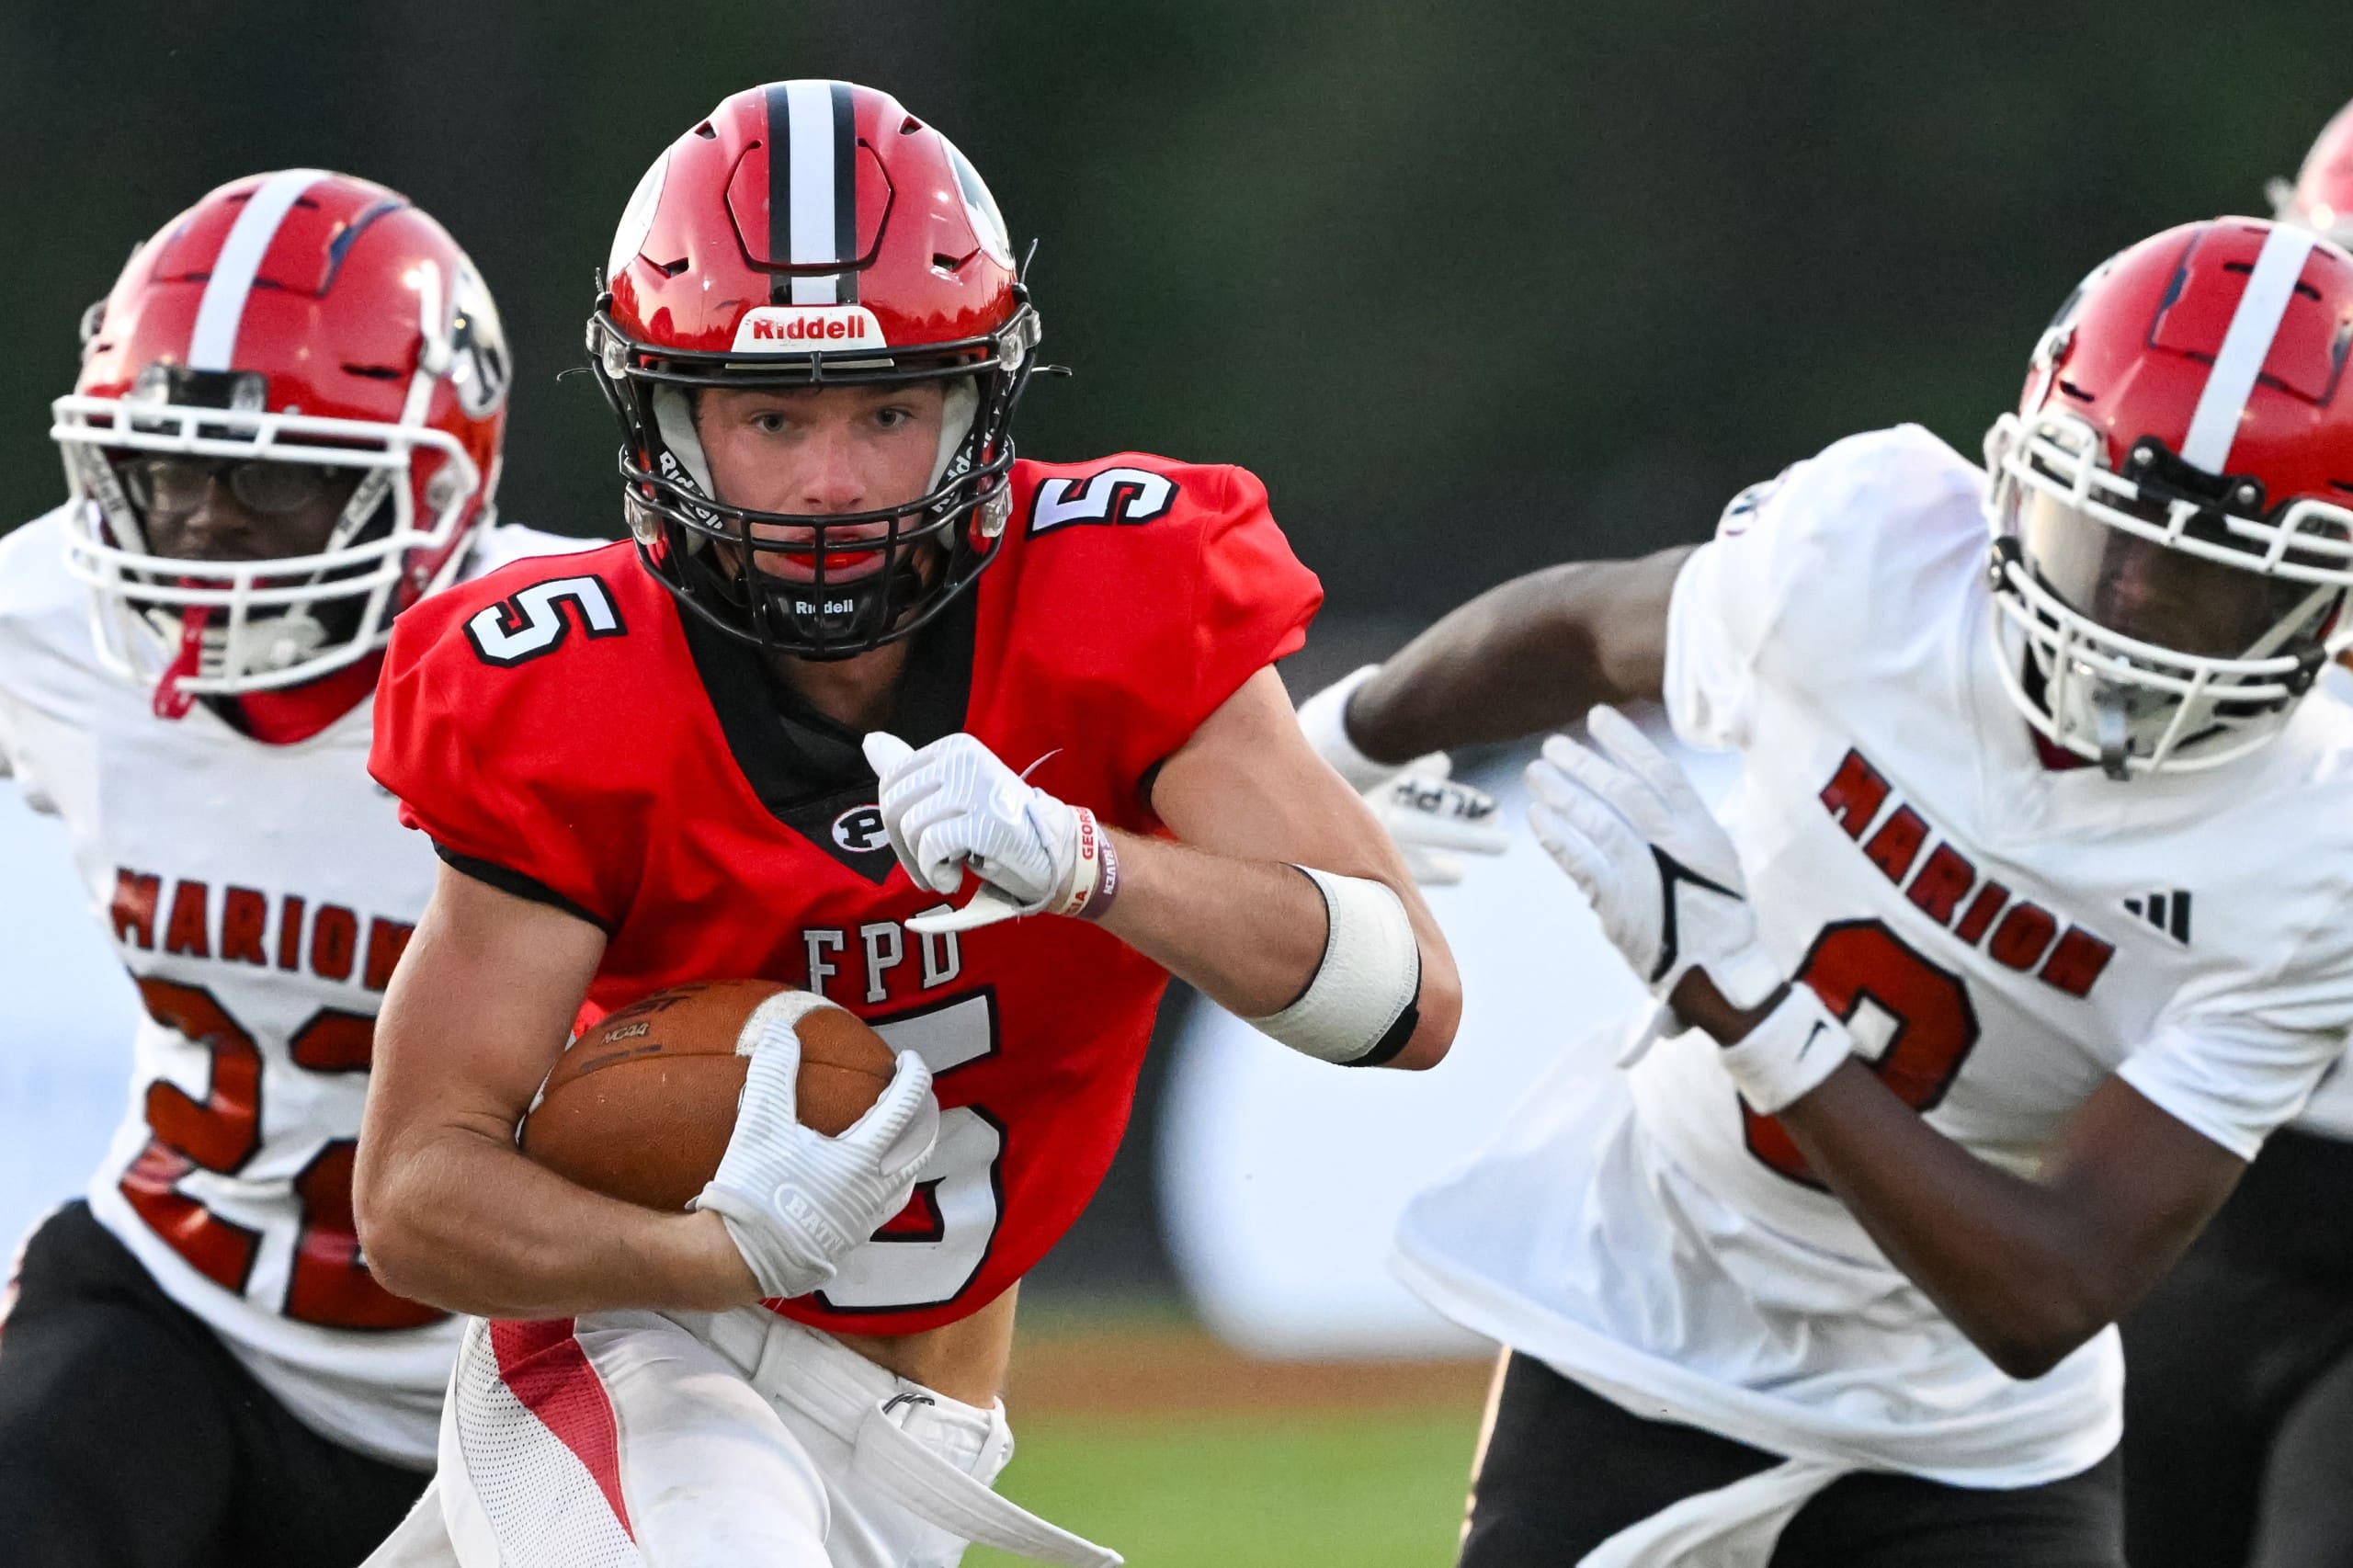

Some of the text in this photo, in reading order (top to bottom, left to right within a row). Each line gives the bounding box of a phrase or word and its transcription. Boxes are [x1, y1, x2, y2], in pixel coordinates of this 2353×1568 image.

[752, 314, 866, 340] Riddell
[659, 450, 724, 530] Riell
[1024, 466, 1180, 541] 5
[460, 574, 629, 669] 5
[795, 598, 854, 615] Ridell
[837, 808, 885, 848] P
[1819, 746, 2116, 998] MARION
[109, 866, 417, 993] MARION
[802, 903, 962, 1004] FPD
[602, 1022, 651, 1046] NCAA
[813, 983, 1008, 1316] 5
